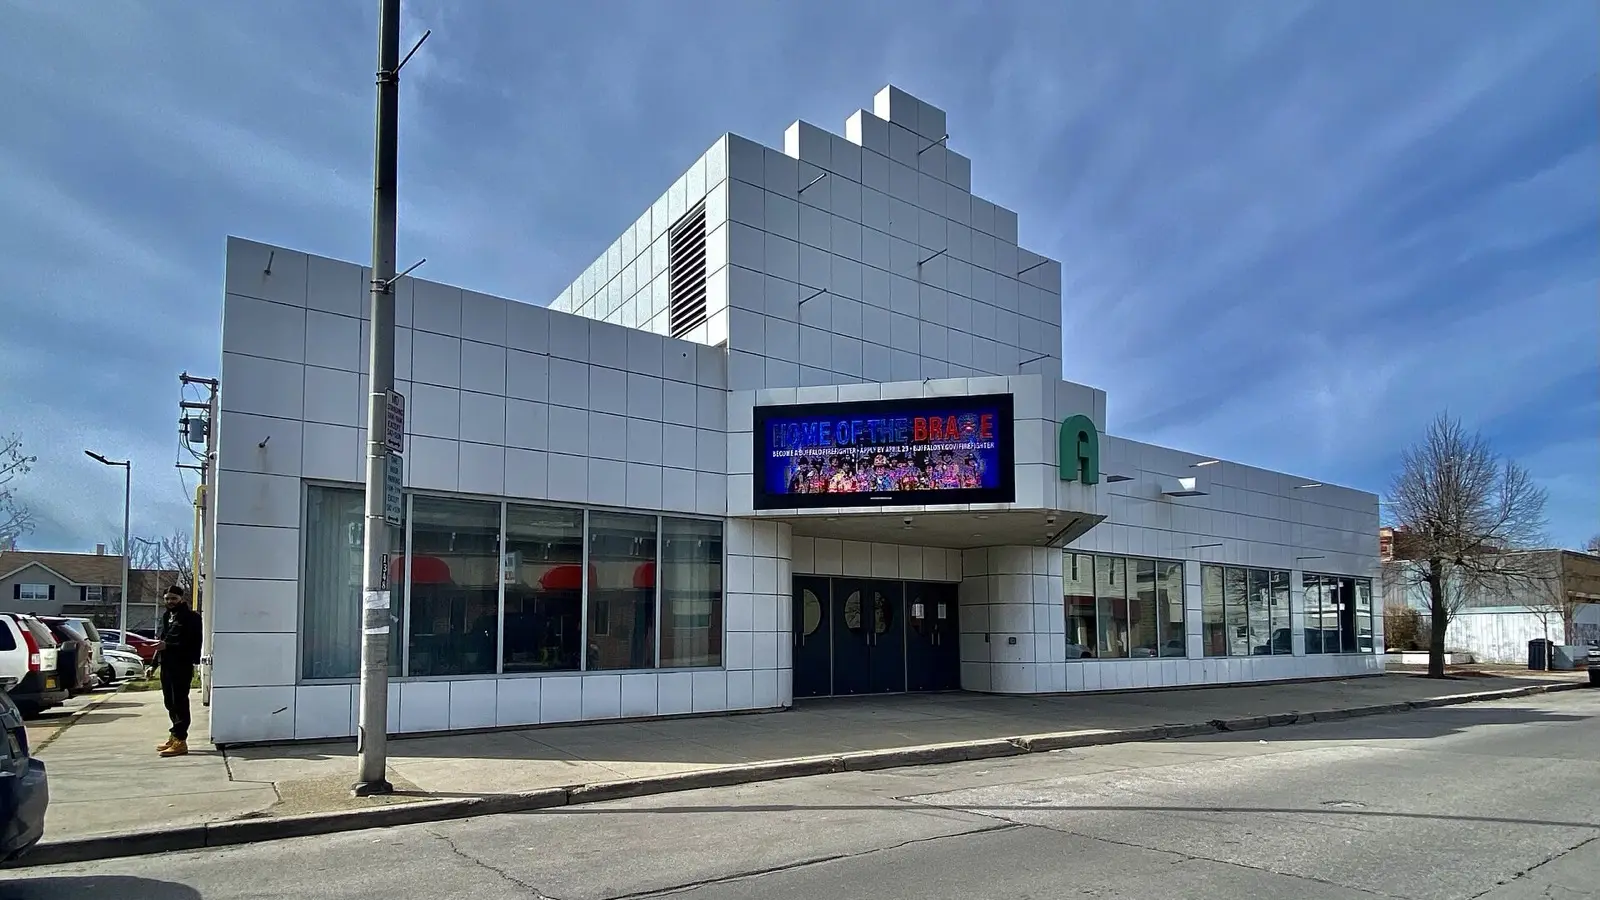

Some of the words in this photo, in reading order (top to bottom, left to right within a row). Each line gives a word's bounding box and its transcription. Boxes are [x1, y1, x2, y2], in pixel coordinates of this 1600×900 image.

[772, 421, 831, 448] HOME
[836, 420, 863, 446] OF
[867, 418, 908, 444] THE
[914, 414, 993, 442] BRAE
[772, 450, 793, 458] BECOME
[799, 448, 822, 456] BUFFALO
